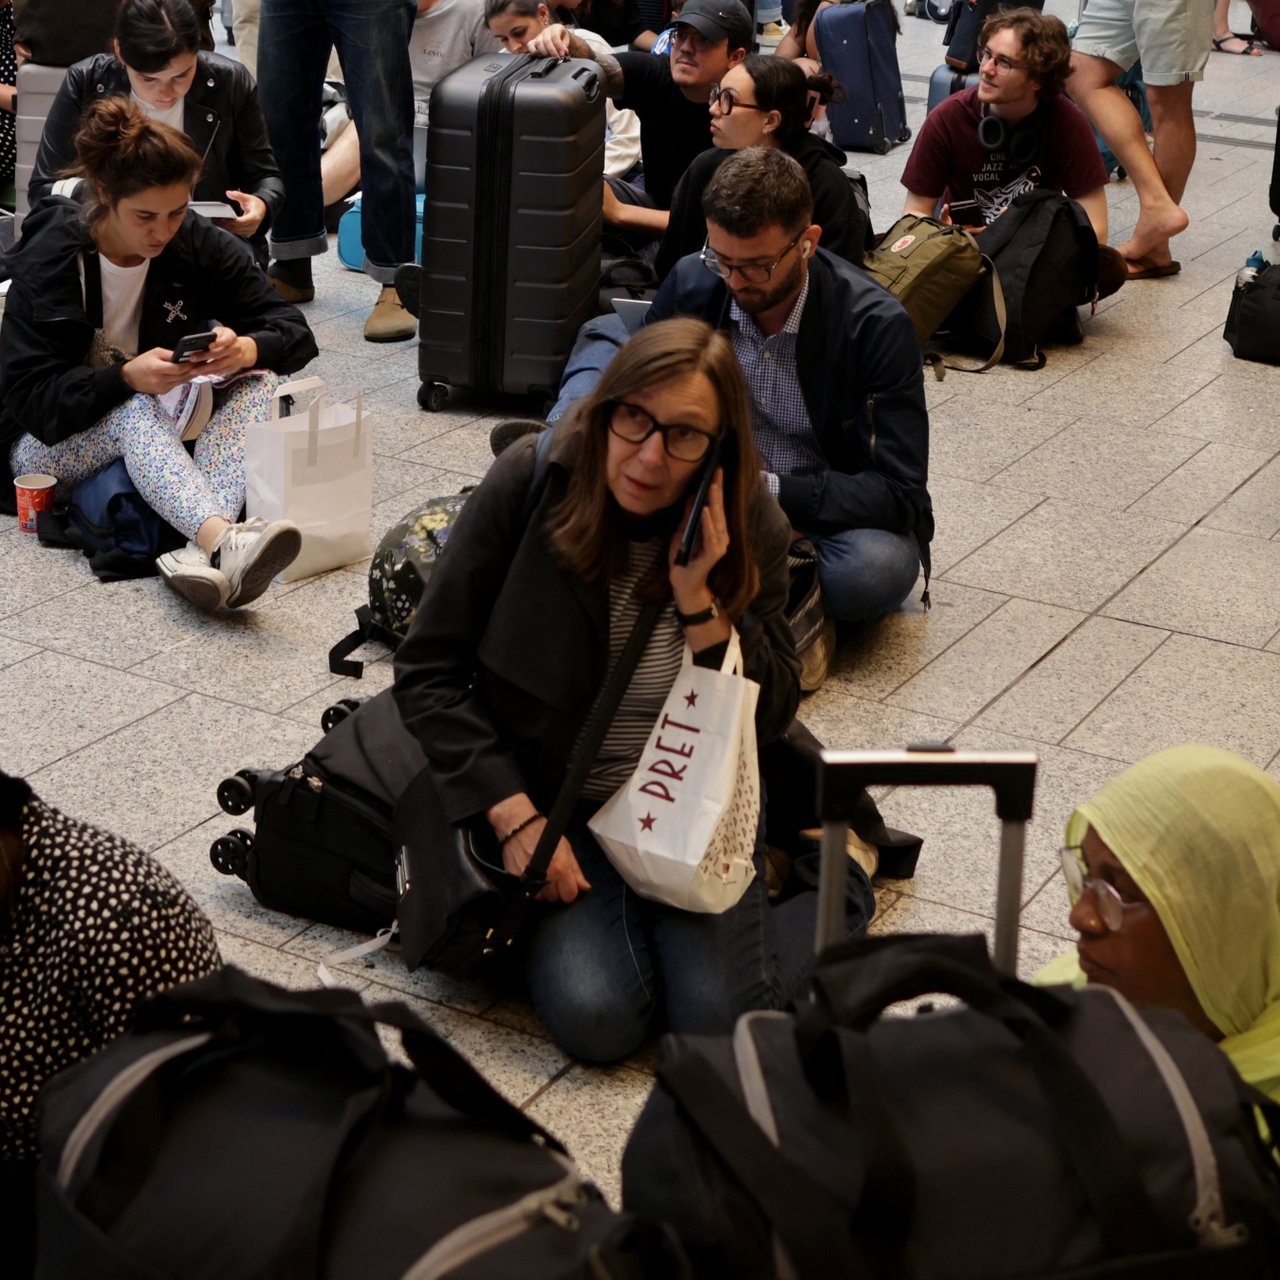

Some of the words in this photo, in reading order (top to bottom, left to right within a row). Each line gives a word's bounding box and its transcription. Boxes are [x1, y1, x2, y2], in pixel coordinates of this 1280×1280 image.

[981, 162, 1004, 172] JAZZ
[972, 172, 1000, 182] VOCAL
[638, 712, 701, 803] PRET
